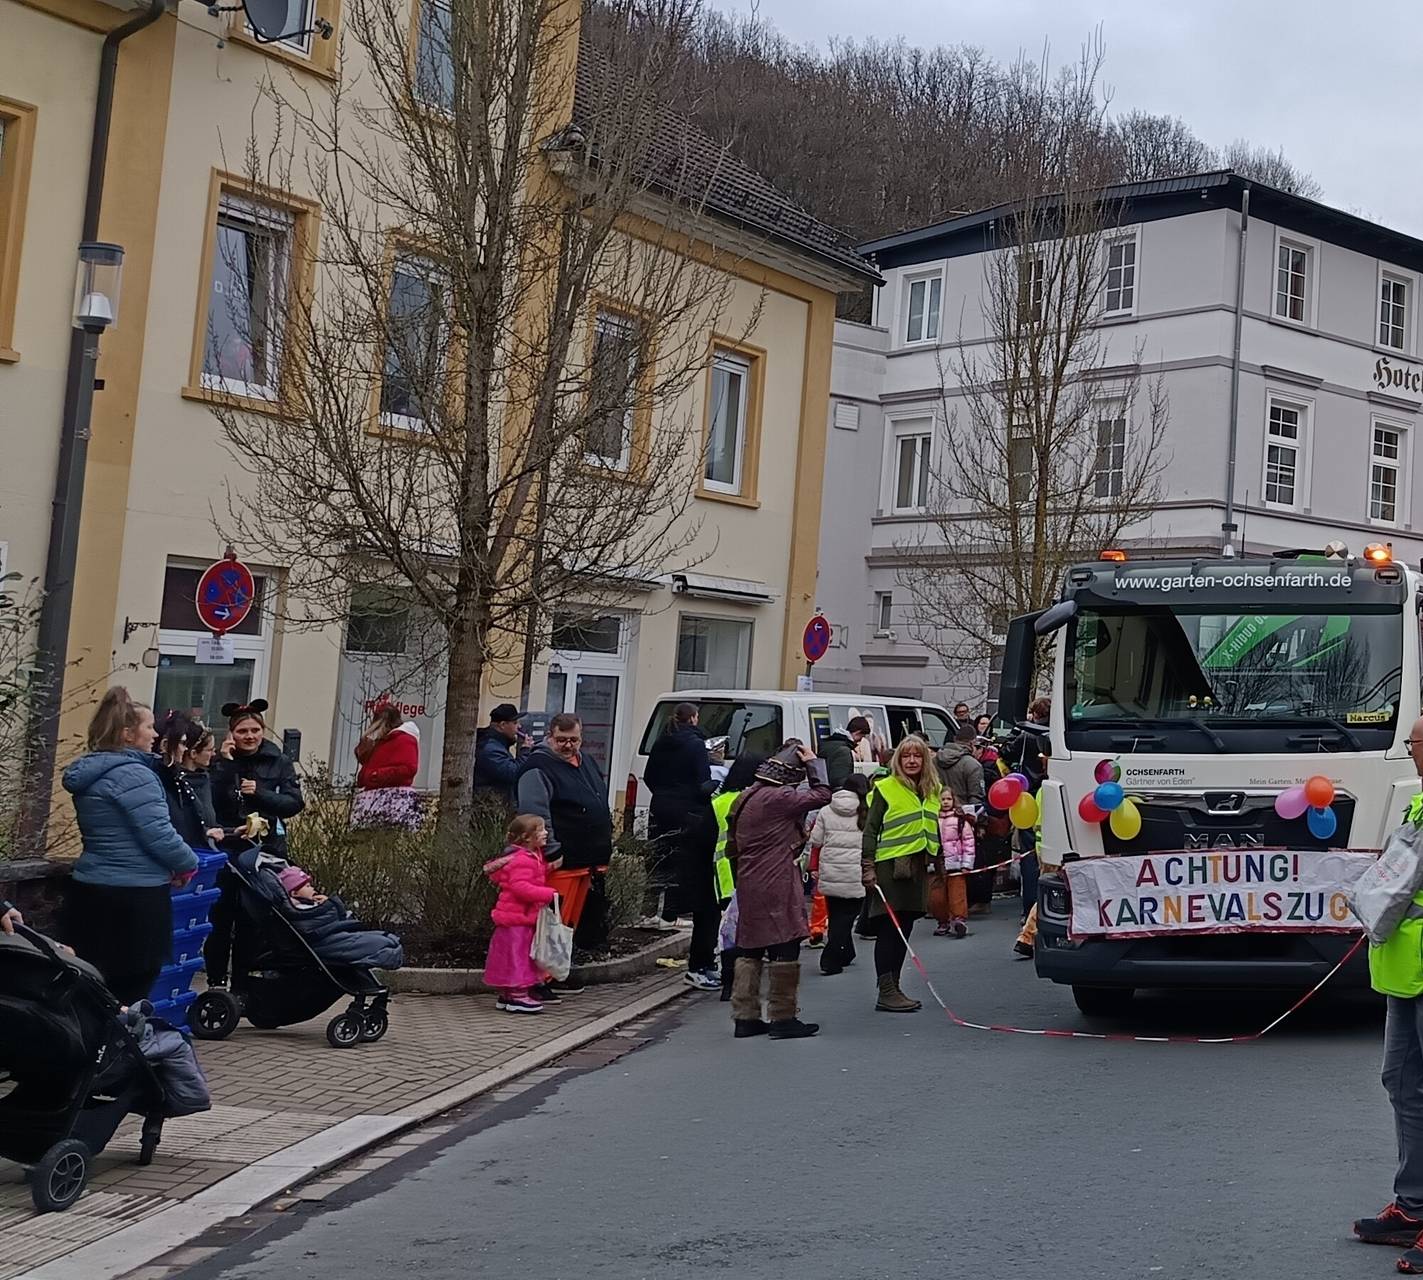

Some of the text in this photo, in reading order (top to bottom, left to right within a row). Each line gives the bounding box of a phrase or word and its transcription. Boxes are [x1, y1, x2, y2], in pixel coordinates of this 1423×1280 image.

[1115, 573, 1352, 592] www.garten-ochsenfarth.de
[1126, 768, 1185, 776] OCHSENFARTH
[1126, 777, 1155, 786] Gärtner
[1157, 778, 1171, 786] von
[1249, 777, 1267, 785] Mein
[1183, 833, 1265, 849] MAN
[1136, 854, 1299, 888] ACHTUNG!
[1099, 892, 1348, 927] KARNEVALSZUG
